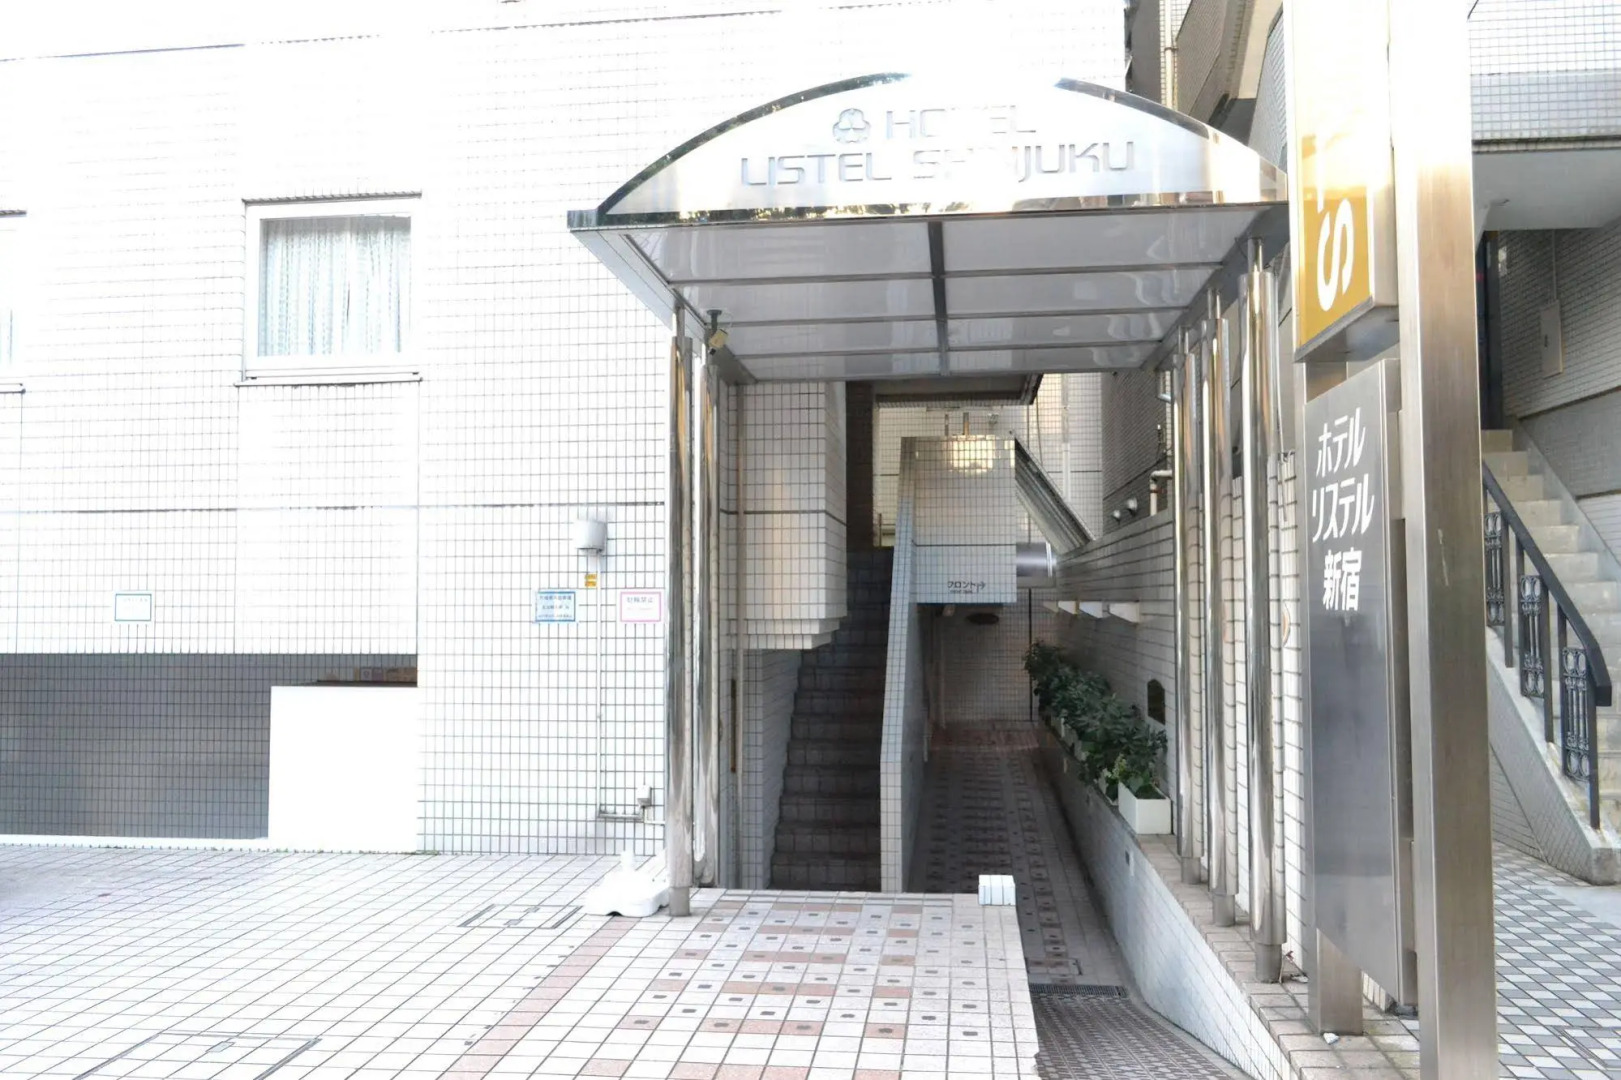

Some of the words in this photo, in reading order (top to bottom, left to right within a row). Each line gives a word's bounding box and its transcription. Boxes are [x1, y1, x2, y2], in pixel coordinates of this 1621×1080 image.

[886, 104, 1036, 139] HOEL
[741, 152, 892, 186] LISTEL
[913, 141, 1135, 183] SJUKU
[1316, 407, 1366, 477] ホテル
[1312, 473, 1375, 543] リステル
[1323, 547, 1362, 611] 新宿
